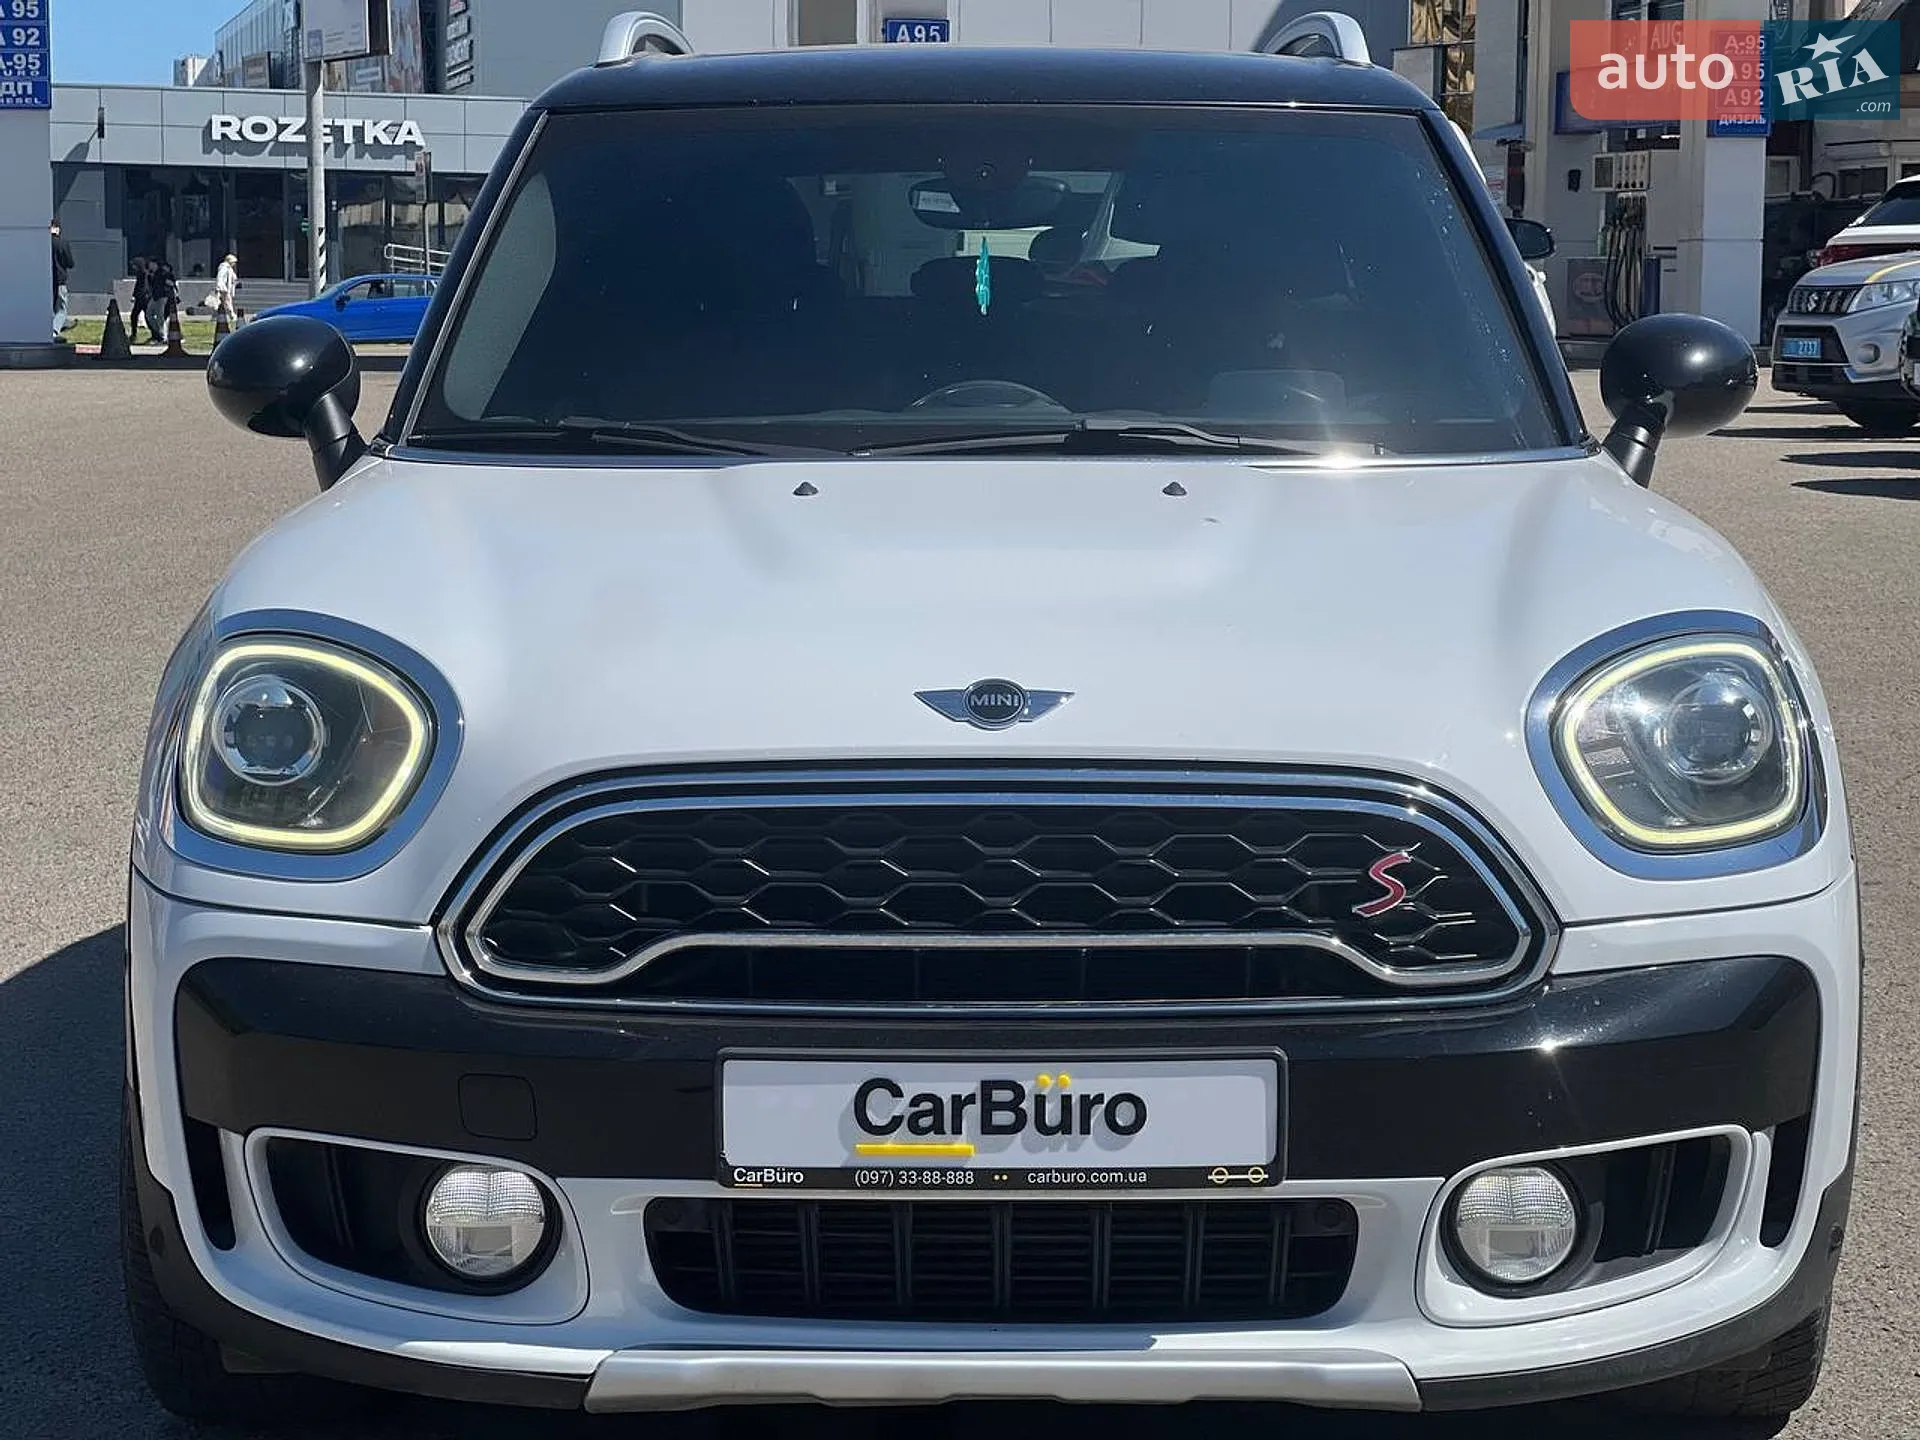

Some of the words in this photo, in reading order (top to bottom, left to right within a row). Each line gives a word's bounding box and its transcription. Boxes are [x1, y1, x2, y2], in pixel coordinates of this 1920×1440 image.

[896, 24, 941, 42] A95
[1723, 88, 1764, 106] A92
[970, 694, 1019, 706] MINI
[1352, 851, 1412, 917] S
[853, 1072, 1148, 1136] CarBüro
[733, 1167, 804, 1184] CarBüro
[854, 1169, 894, 1187] (097)
[899, 1170, 975, 1185] 33-88-888
[1027, 1168, 1148, 1184] carburo.com.ua
